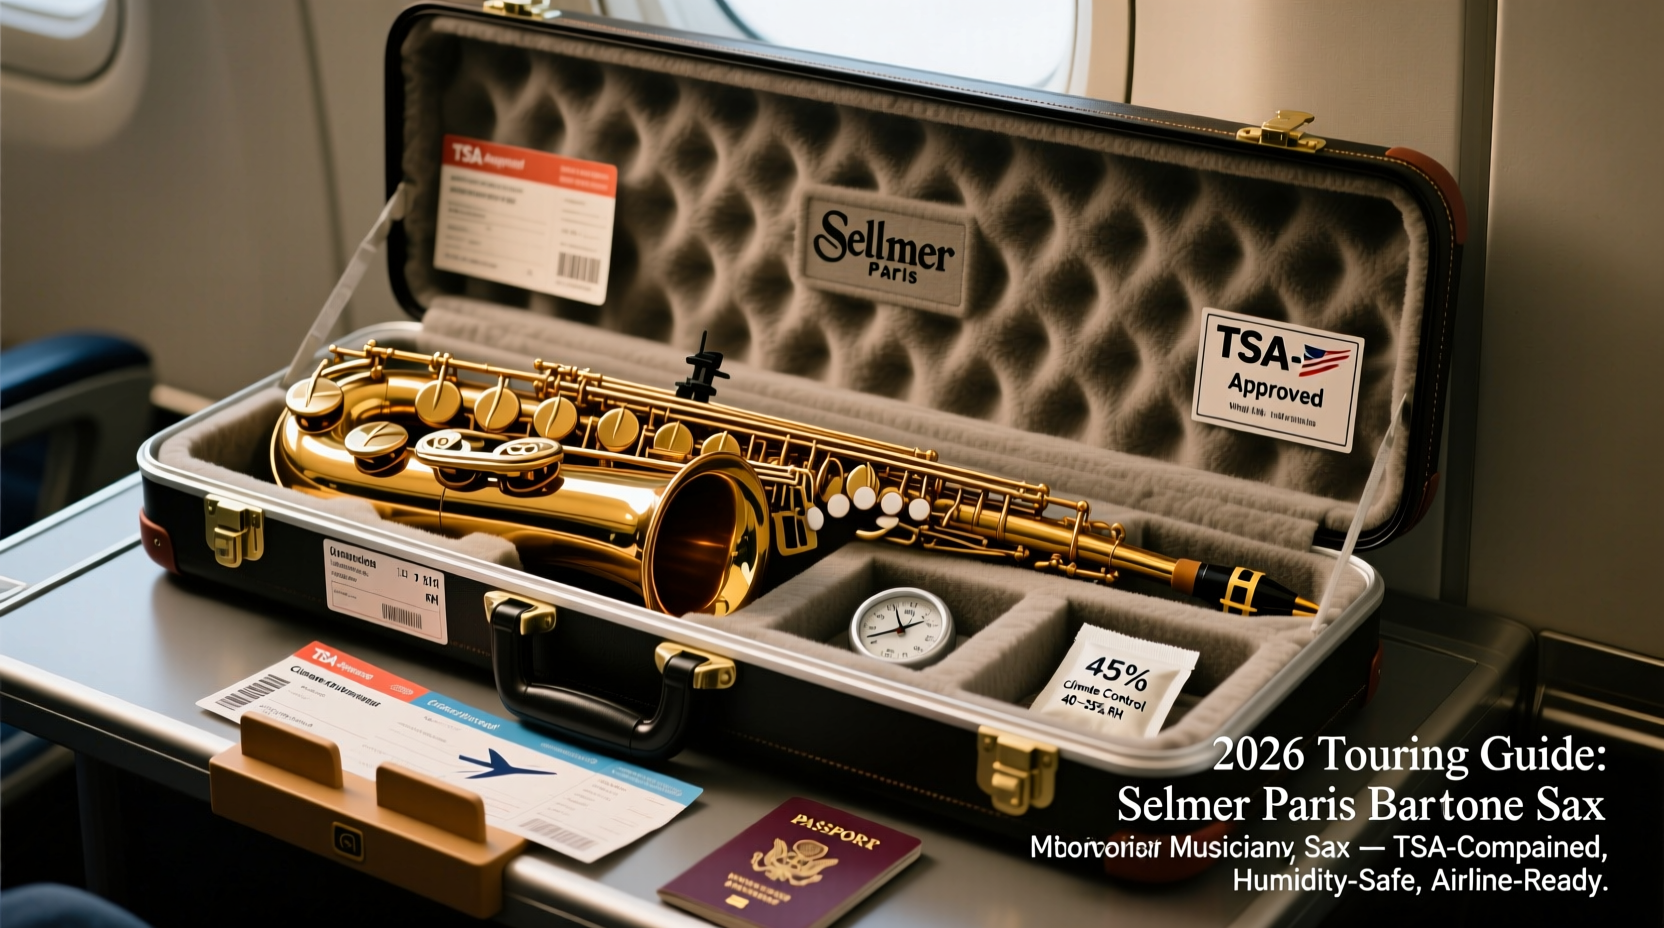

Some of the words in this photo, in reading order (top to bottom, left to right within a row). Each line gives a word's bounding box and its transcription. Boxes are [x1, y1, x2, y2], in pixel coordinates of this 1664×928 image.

[452, 143, 483, 166] TSA
[813, 210, 956, 272] Sellmer
[1228, 372, 1324, 408] Approved
[312, 647, 338, 667] TSA
[1085, 656, 1150, 692] 45%
[1103, 688, 1146, 712] Control
